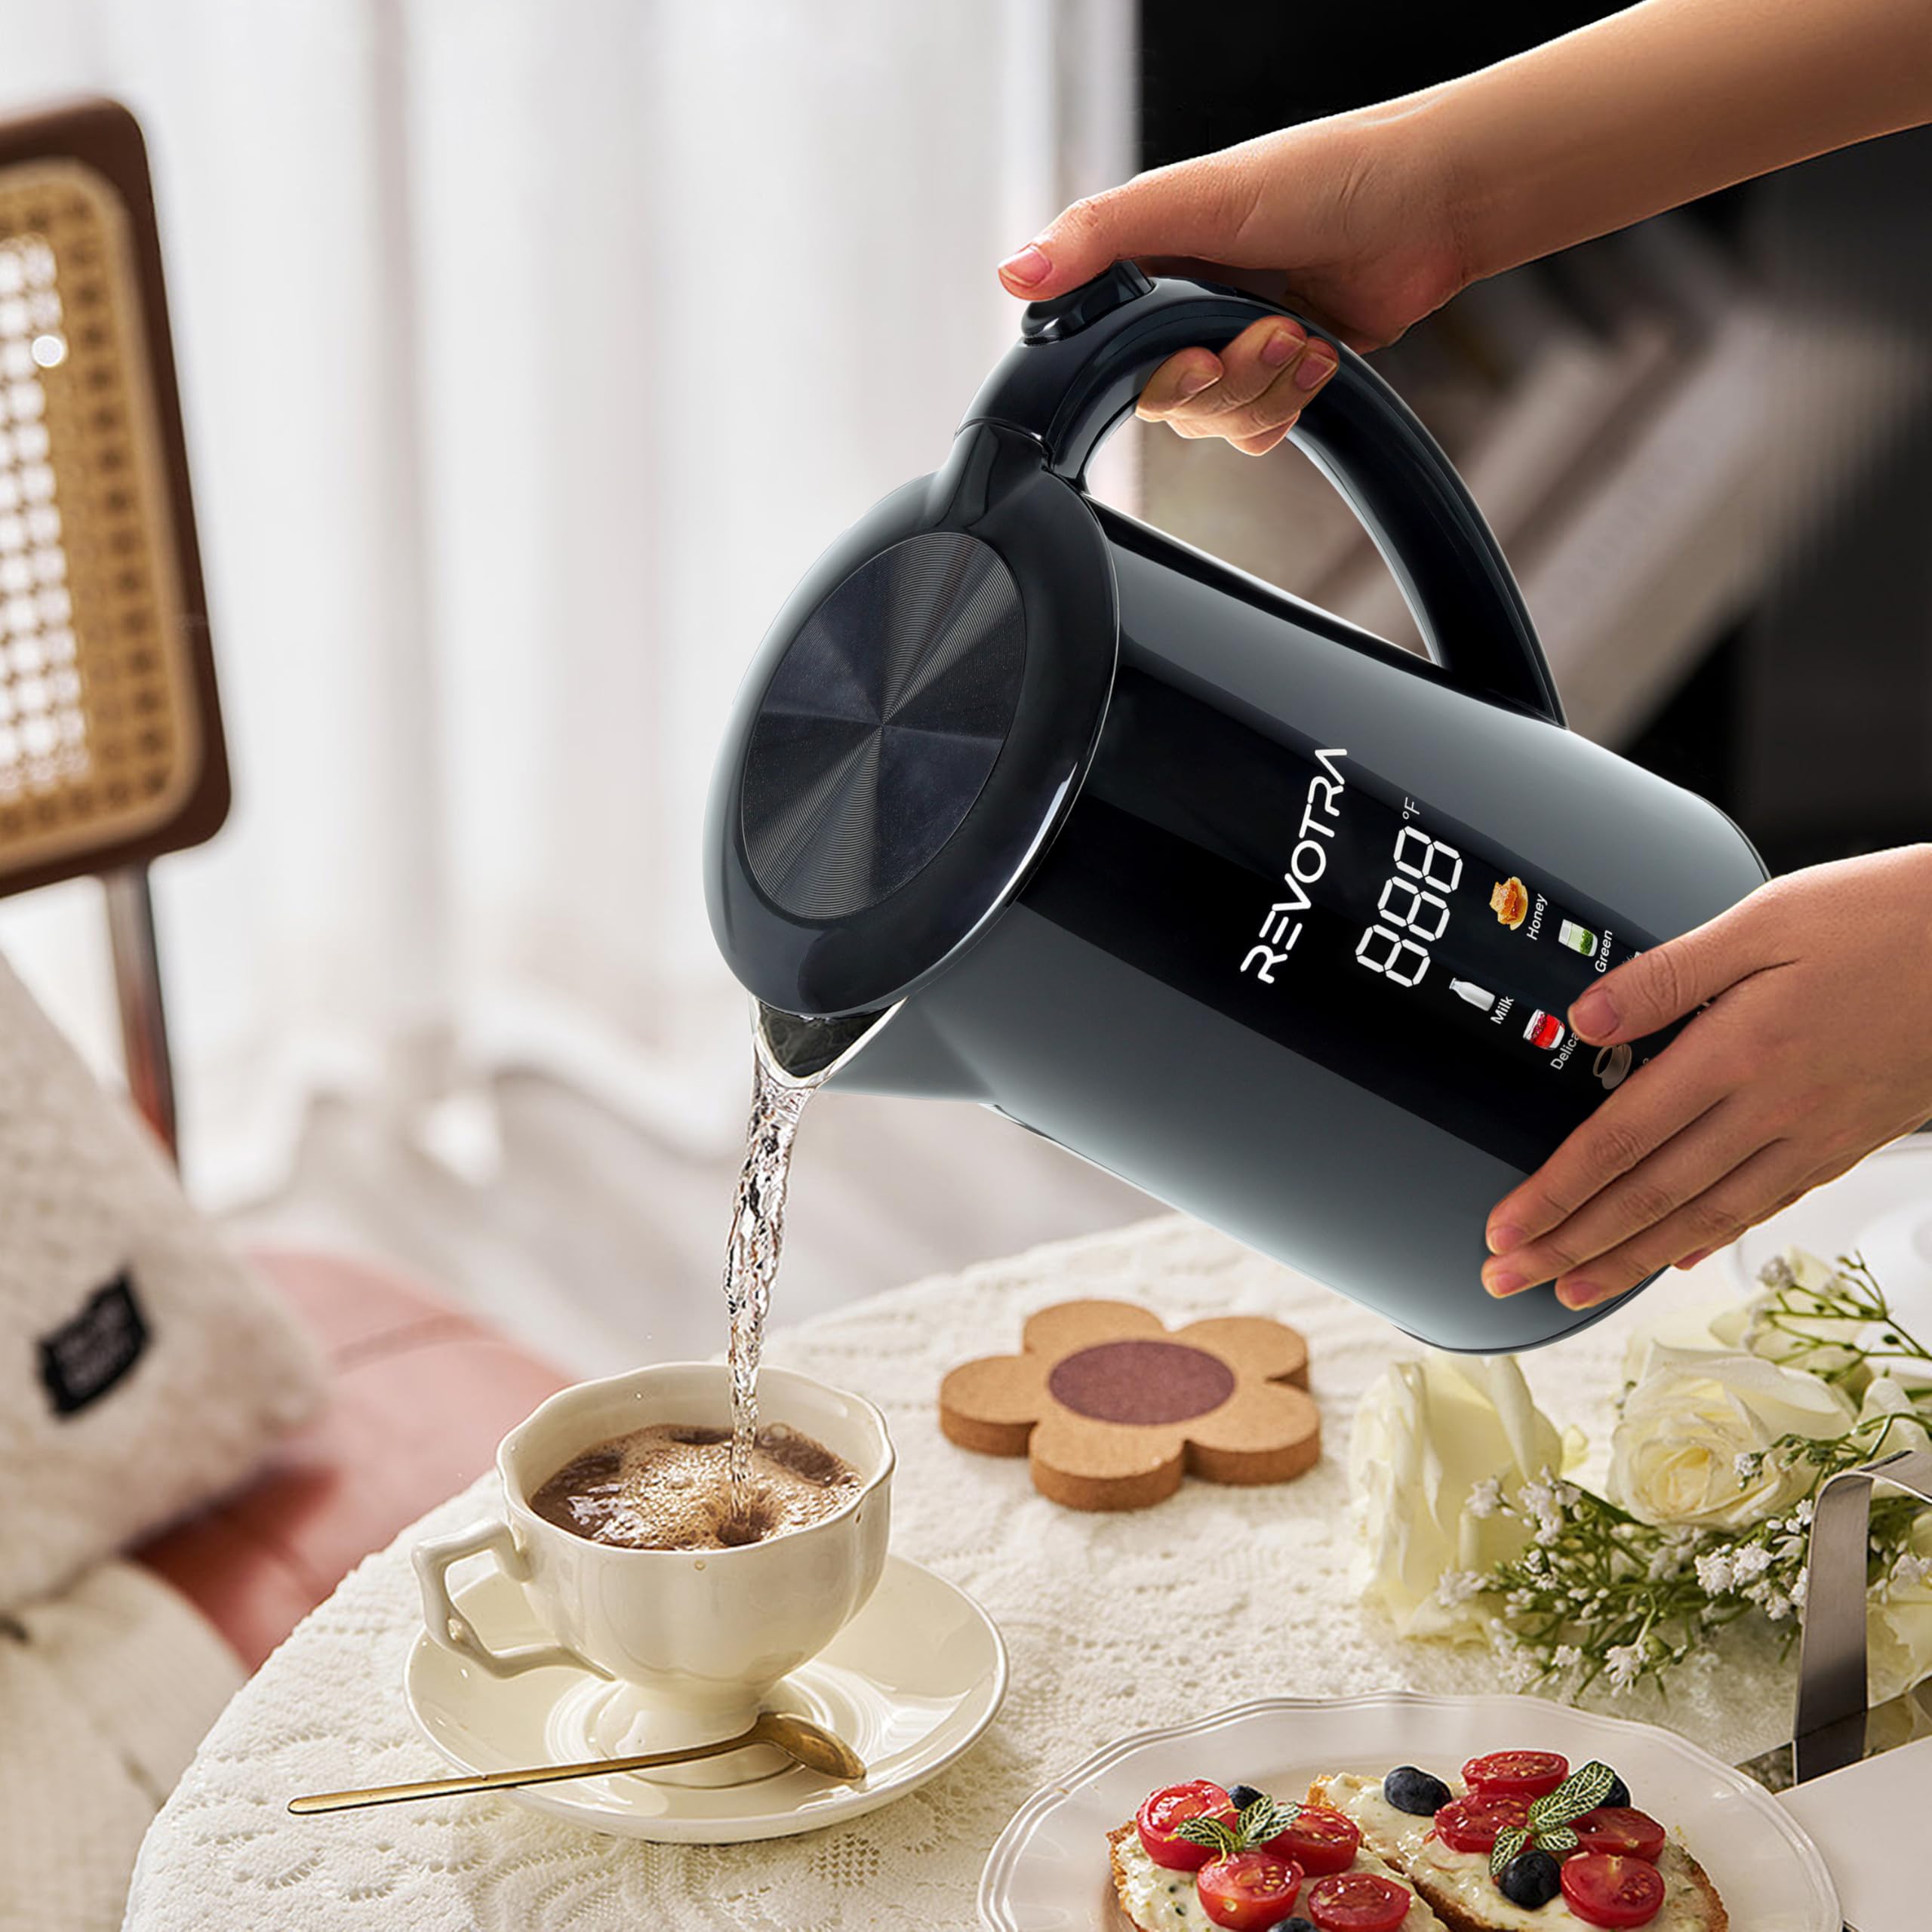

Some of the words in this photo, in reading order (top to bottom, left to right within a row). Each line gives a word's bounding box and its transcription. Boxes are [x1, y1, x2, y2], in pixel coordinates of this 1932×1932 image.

[1240, 748, 1348, 984] REVOTRA
[1355, 825, 1463, 988] 888
[1526, 893, 1548, 940] Honey
[1594, 929, 1614, 973] Green
[1489, 995, 1515, 1025] Milk
